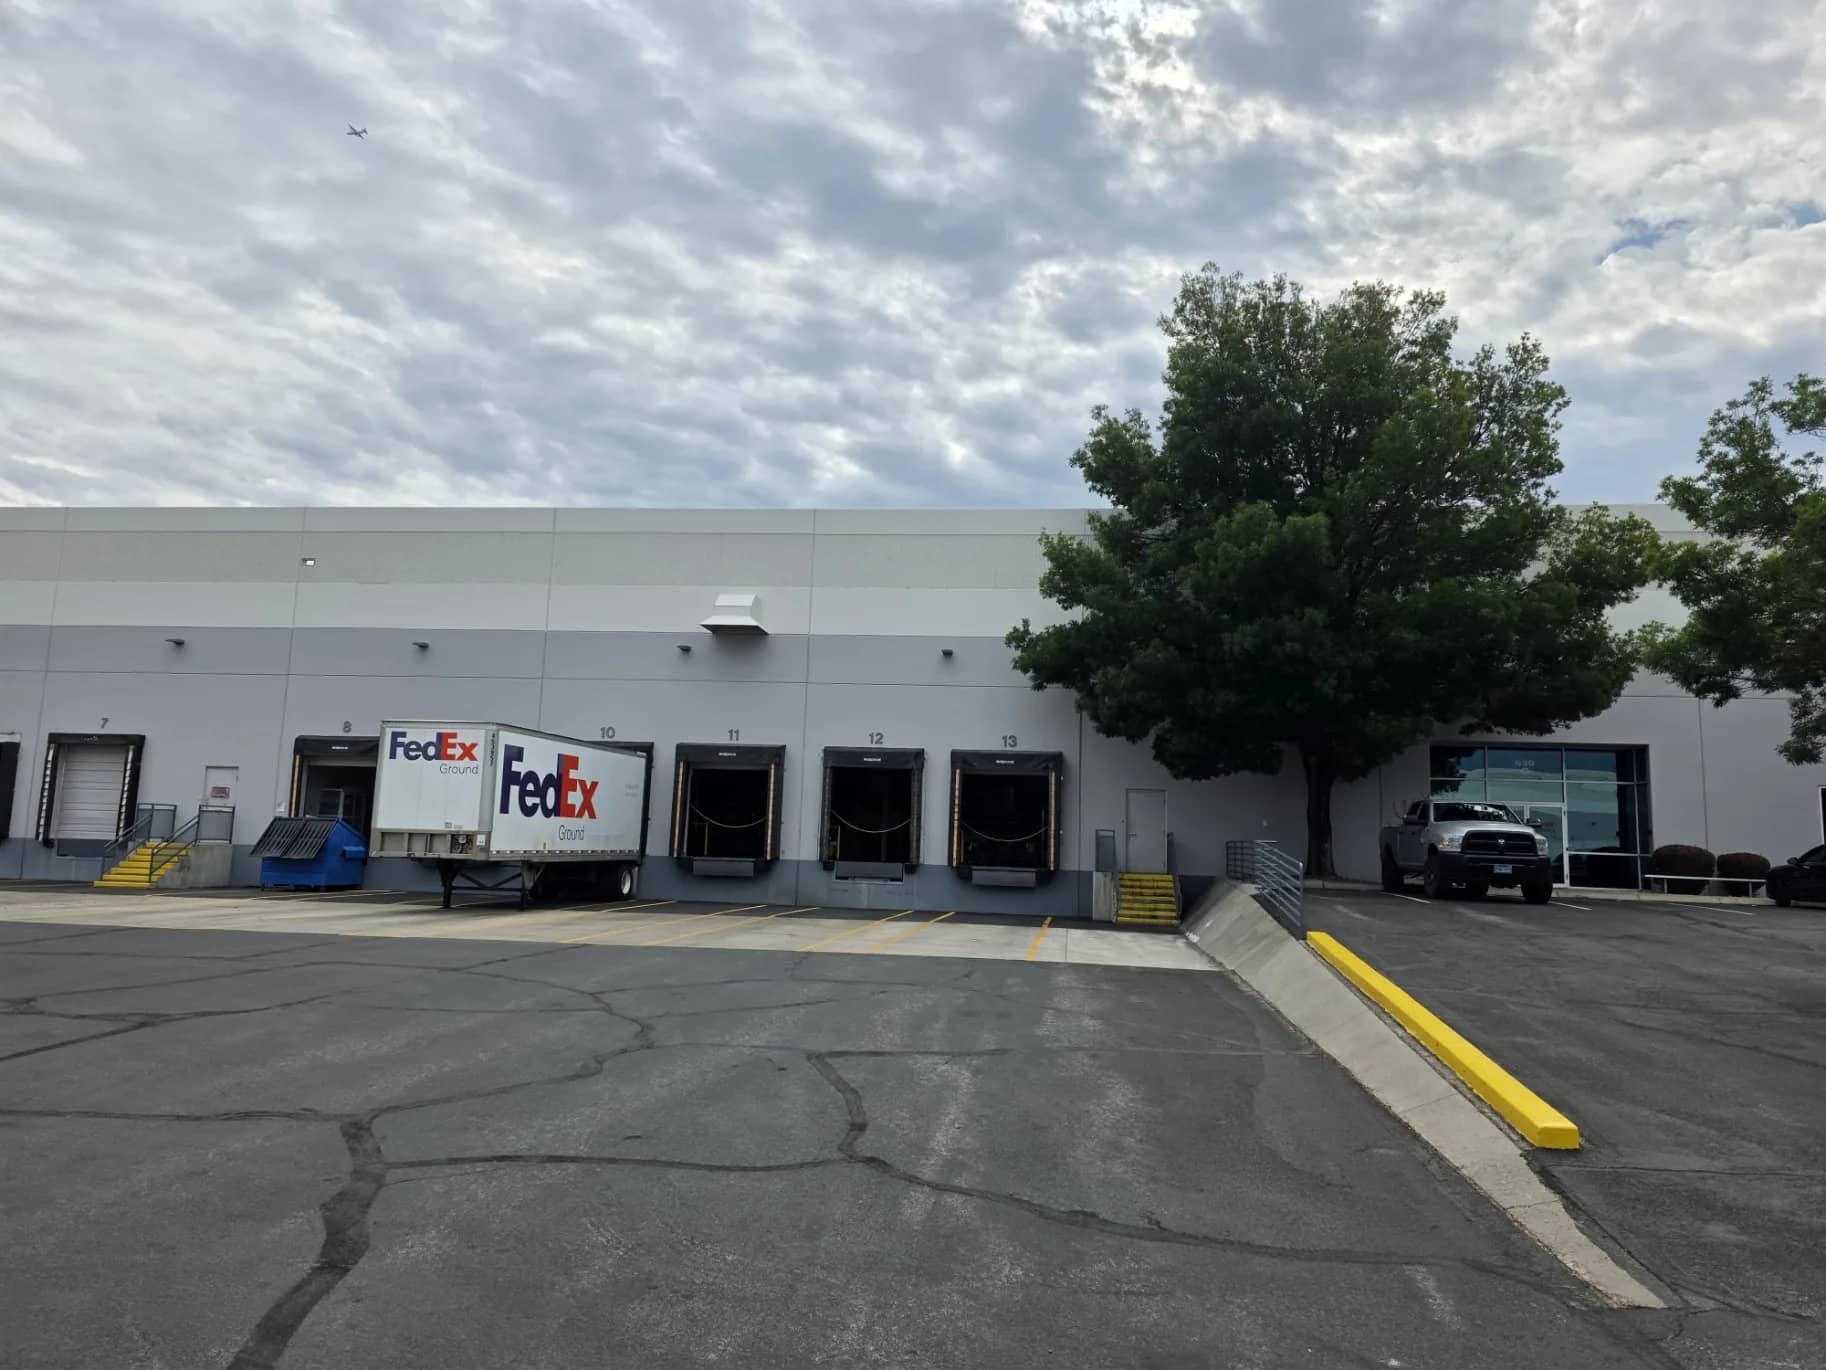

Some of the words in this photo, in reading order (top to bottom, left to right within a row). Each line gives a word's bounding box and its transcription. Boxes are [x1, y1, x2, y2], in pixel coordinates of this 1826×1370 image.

[100, 717, 109, 728] 7
[343, 721, 352, 733] 8
[600, 727, 616, 739] 10
[728, 729, 740, 741] 11
[868, 732, 884, 745] 12
[389, 731, 479, 761] FedEx
[1001, 734, 1017, 748] 13
[439, 763, 479, 775] Ground
[500, 744, 599, 819] FedEx
[558, 825, 585, 840] Ground
